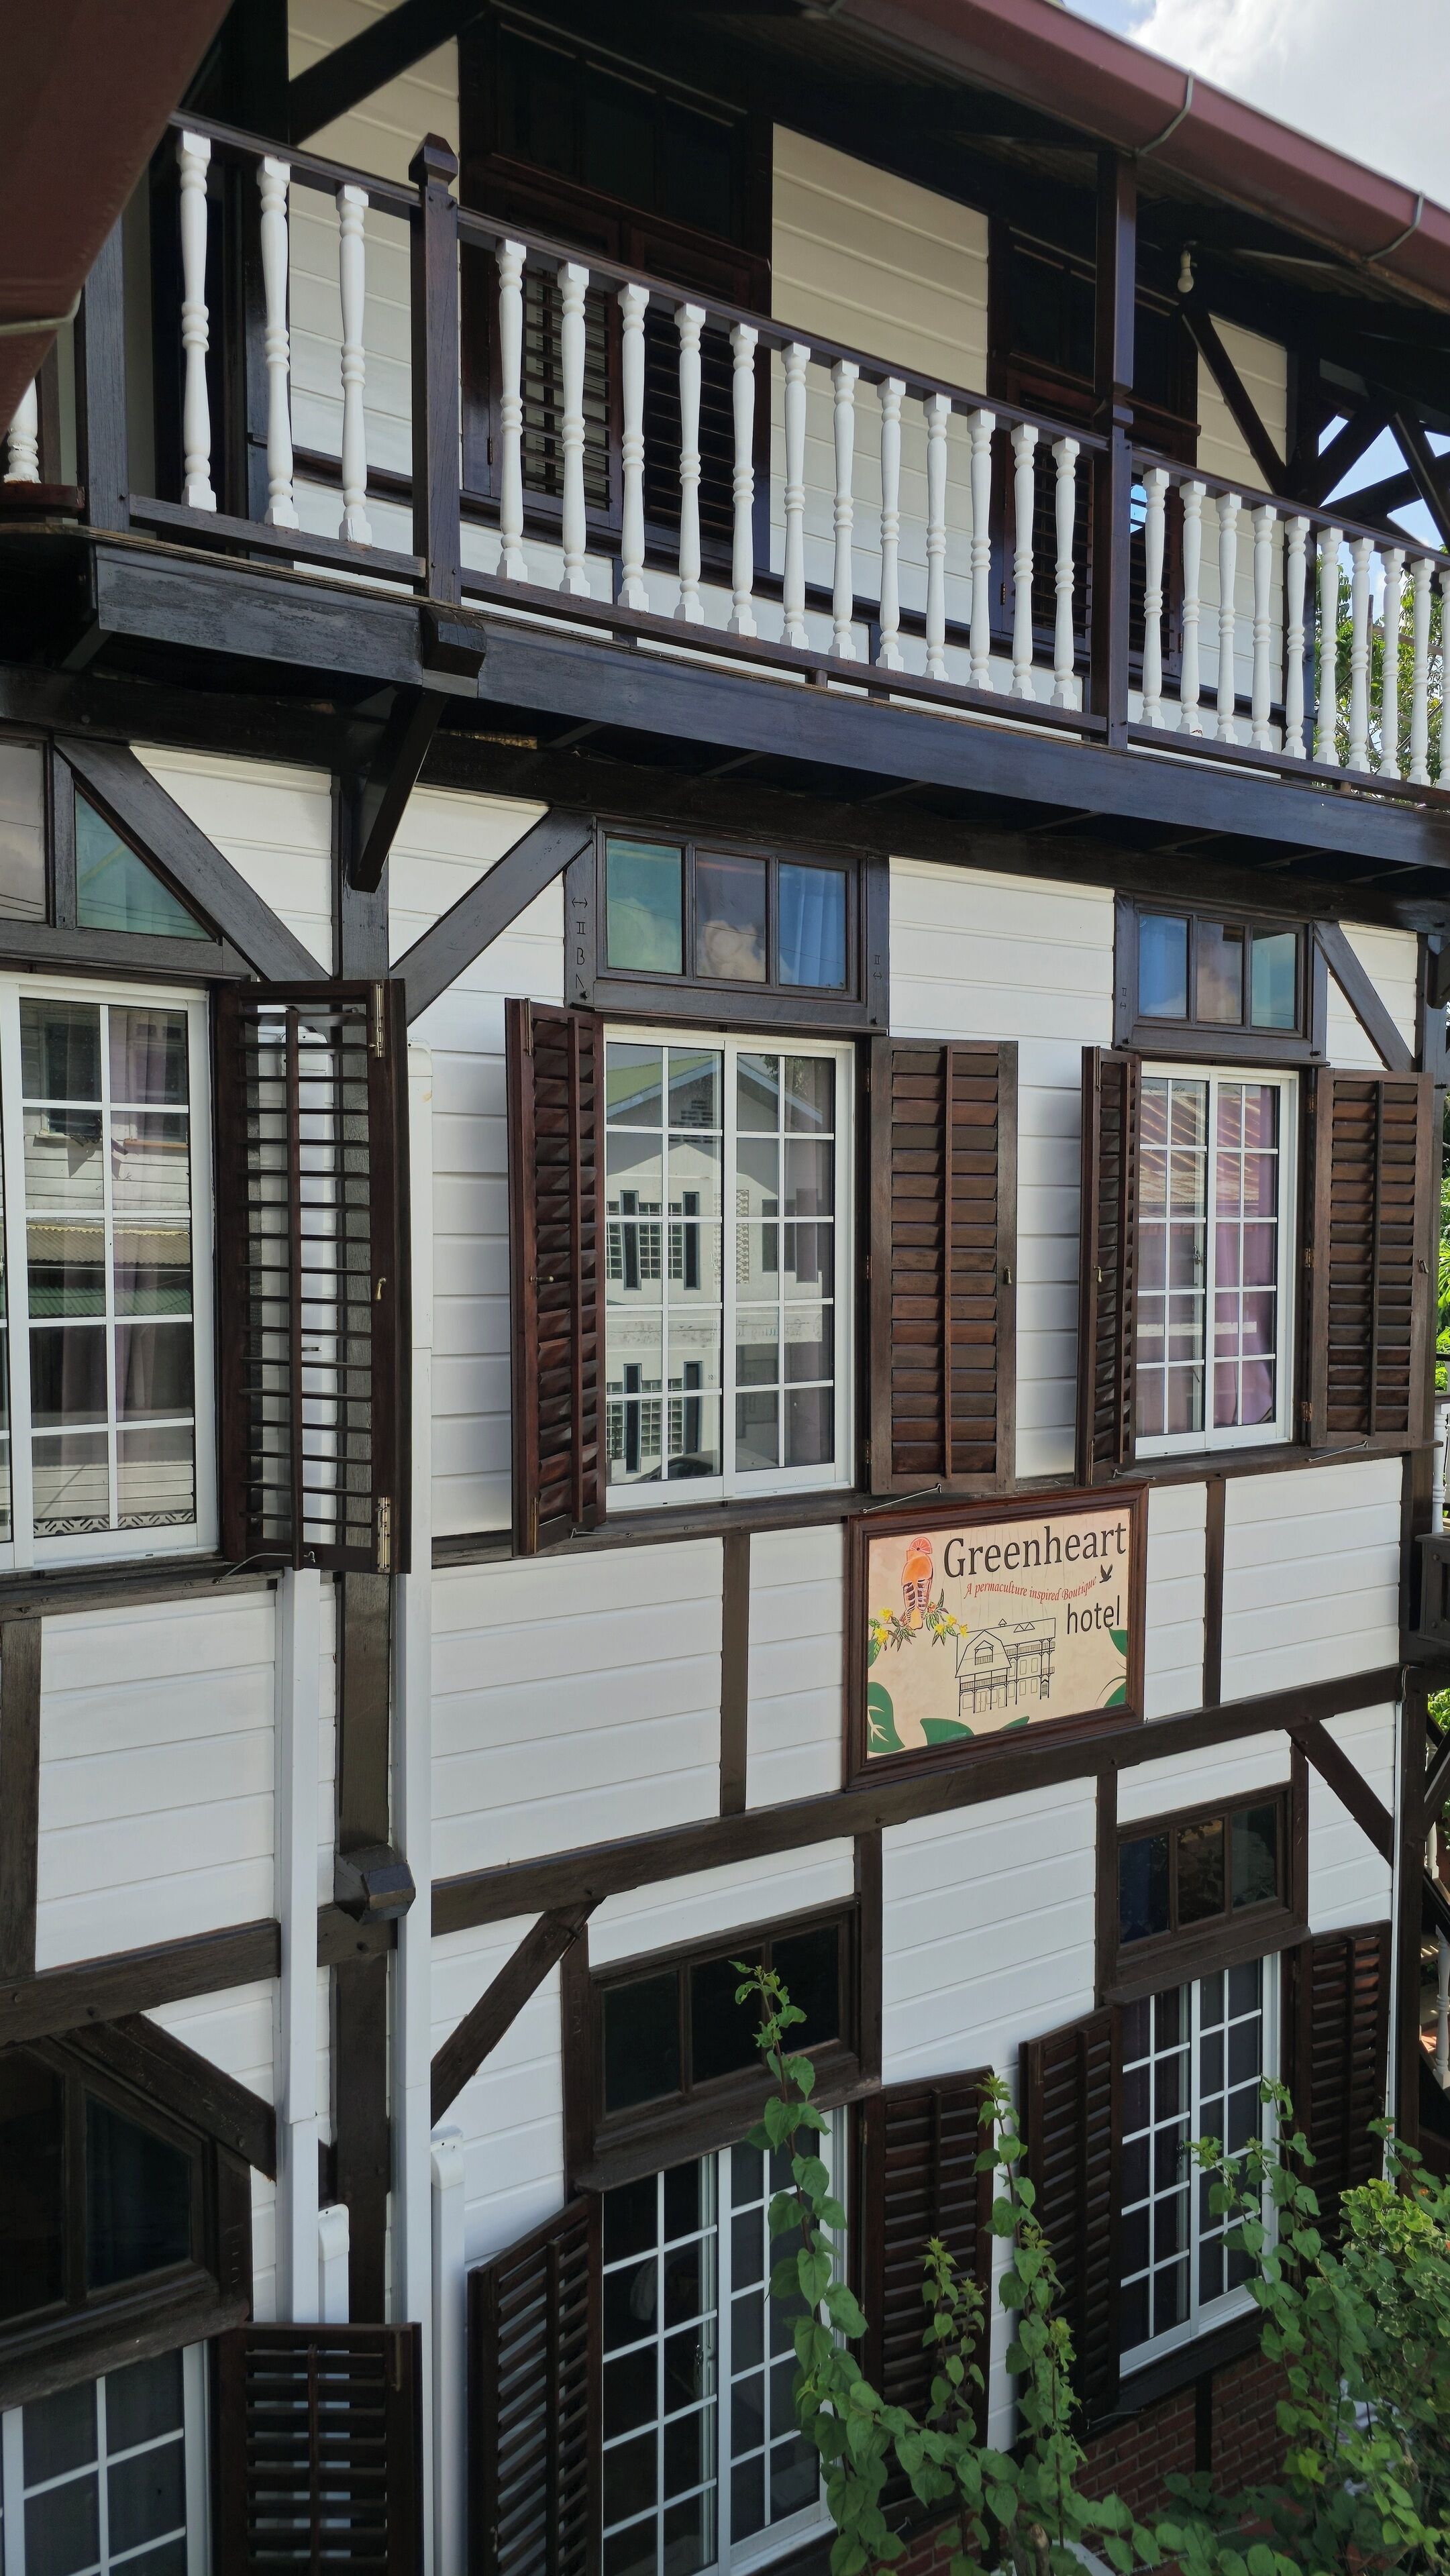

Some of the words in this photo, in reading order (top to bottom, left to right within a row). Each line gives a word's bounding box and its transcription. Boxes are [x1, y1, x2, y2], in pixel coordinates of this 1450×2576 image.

[943, 1522, 1127, 1578] Greenheart
[964, 1582, 973, 1599] A
[974, 1580, 1028, 1598] permaculture
[1029, 1586, 1062, 1604] inspired
[1061, 1576, 1097, 1601] Boutique
[1067, 1595, 1120, 1635] hotel
